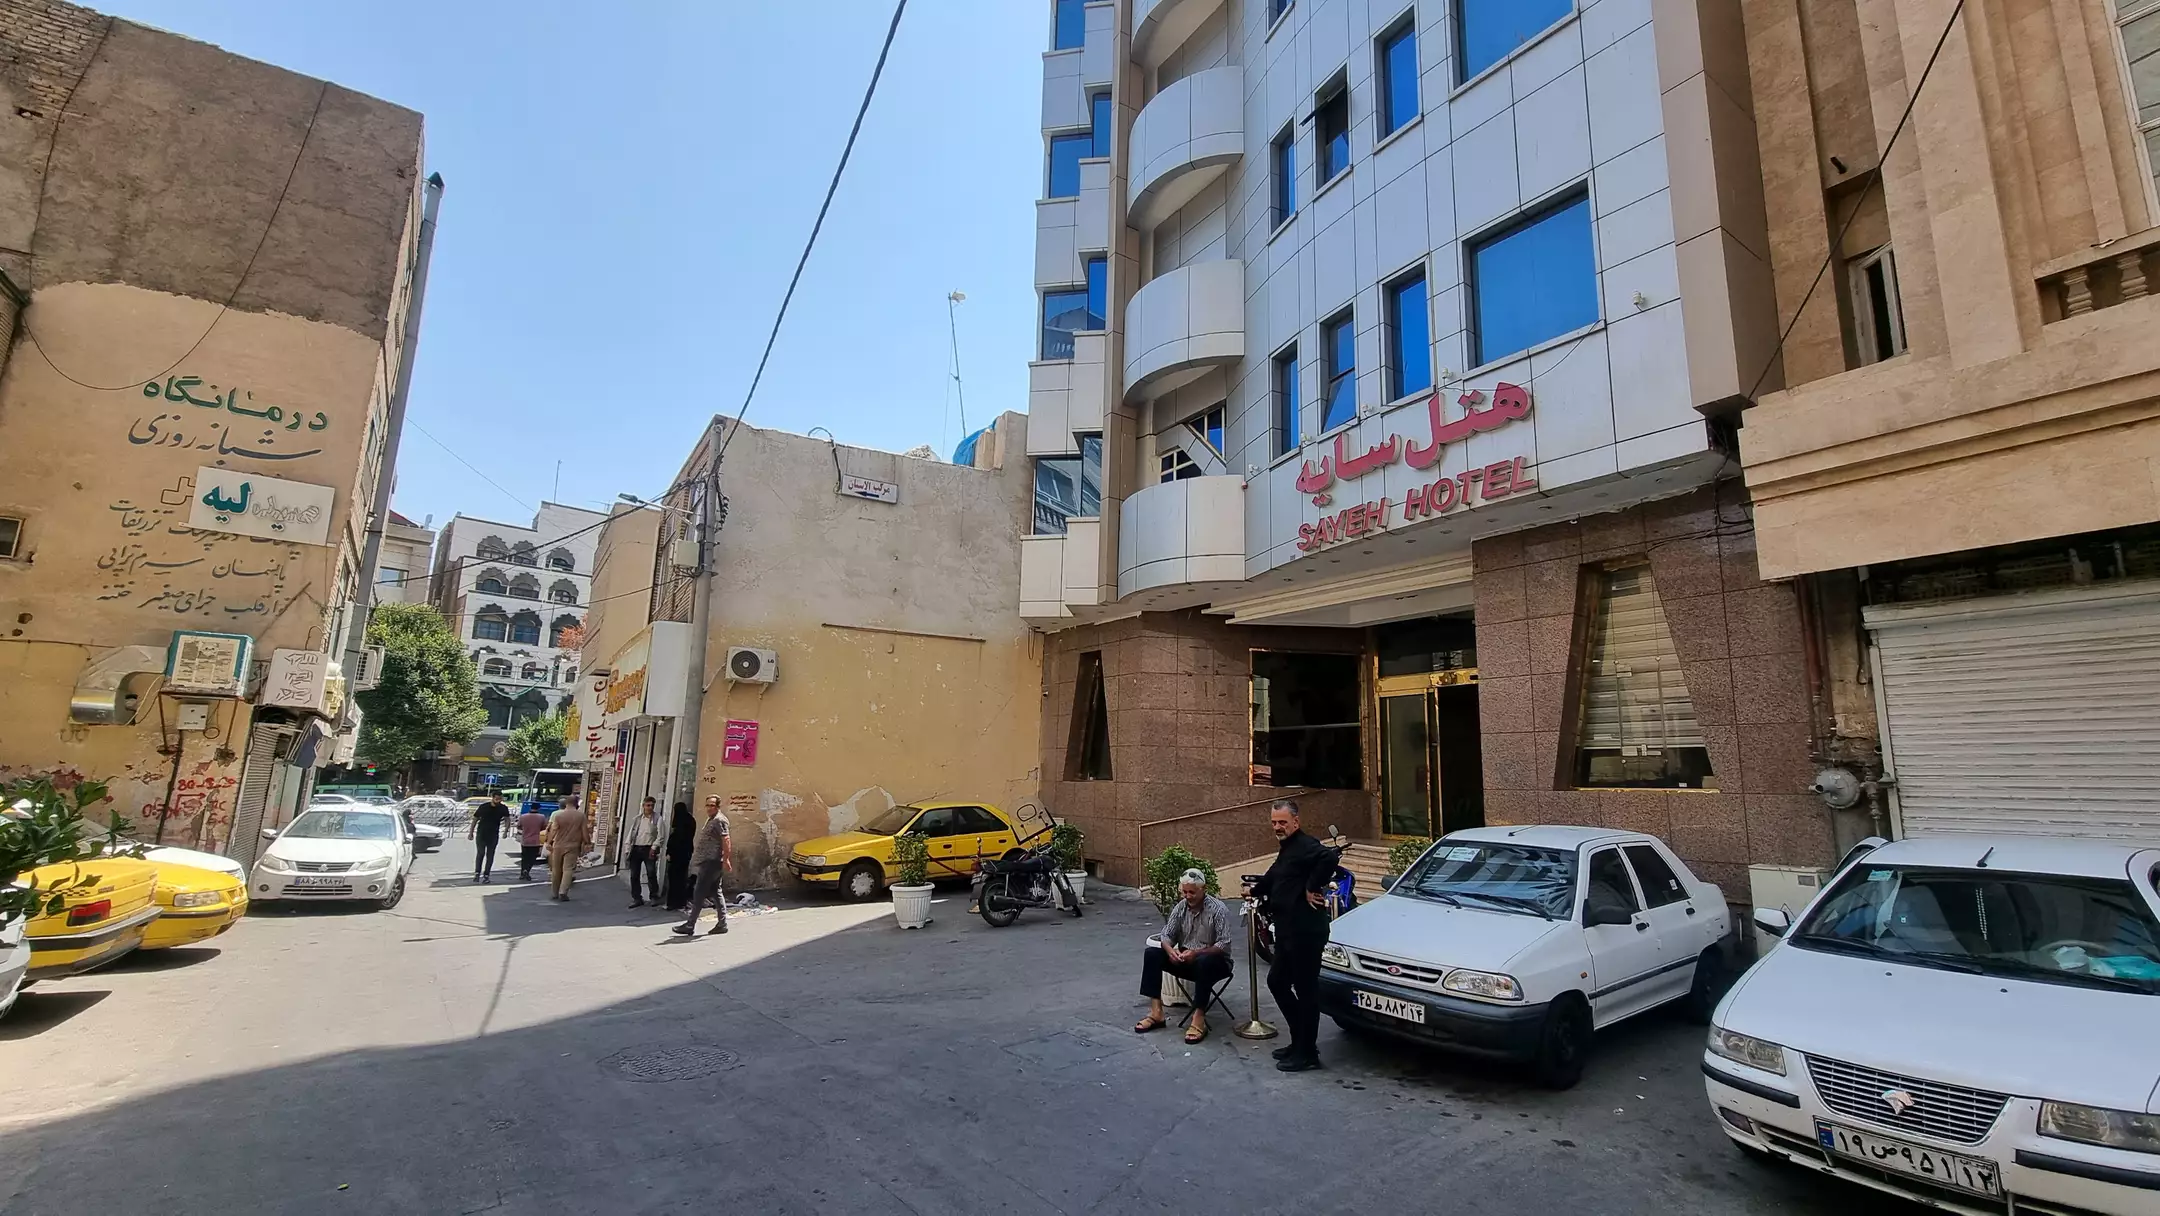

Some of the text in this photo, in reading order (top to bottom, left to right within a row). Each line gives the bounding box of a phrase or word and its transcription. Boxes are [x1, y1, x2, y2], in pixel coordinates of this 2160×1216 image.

[143, 375, 328, 431] درمانگاه
[1295, 381, 1533, 508] هتل سایه
[1296, 455, 1538, 551] SAYEH HOTEL
[1838, 1131, 1867, 1156] ۱۹
[1900, 1147, 1953, 1179] ۹۵۱
